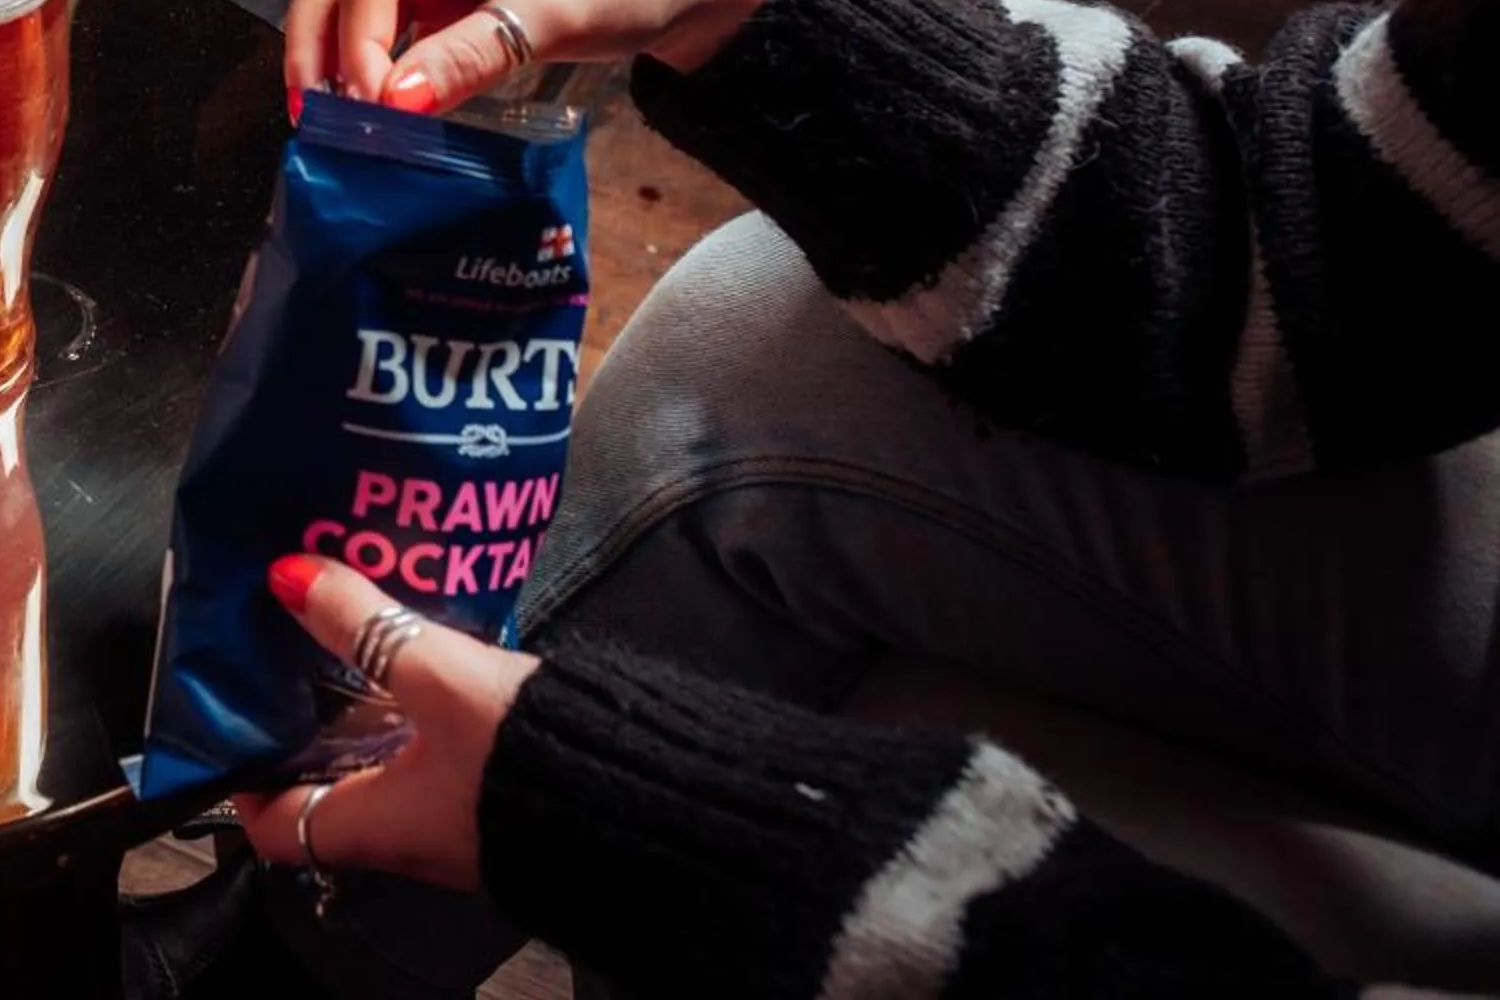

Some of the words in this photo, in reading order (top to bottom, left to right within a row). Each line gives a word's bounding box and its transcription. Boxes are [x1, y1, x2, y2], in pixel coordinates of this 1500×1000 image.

[454, 256, 572, 289] Lifeboats
[346, 329, 578, 411] BURT
[352, 470, 559, 532] PRAWN
